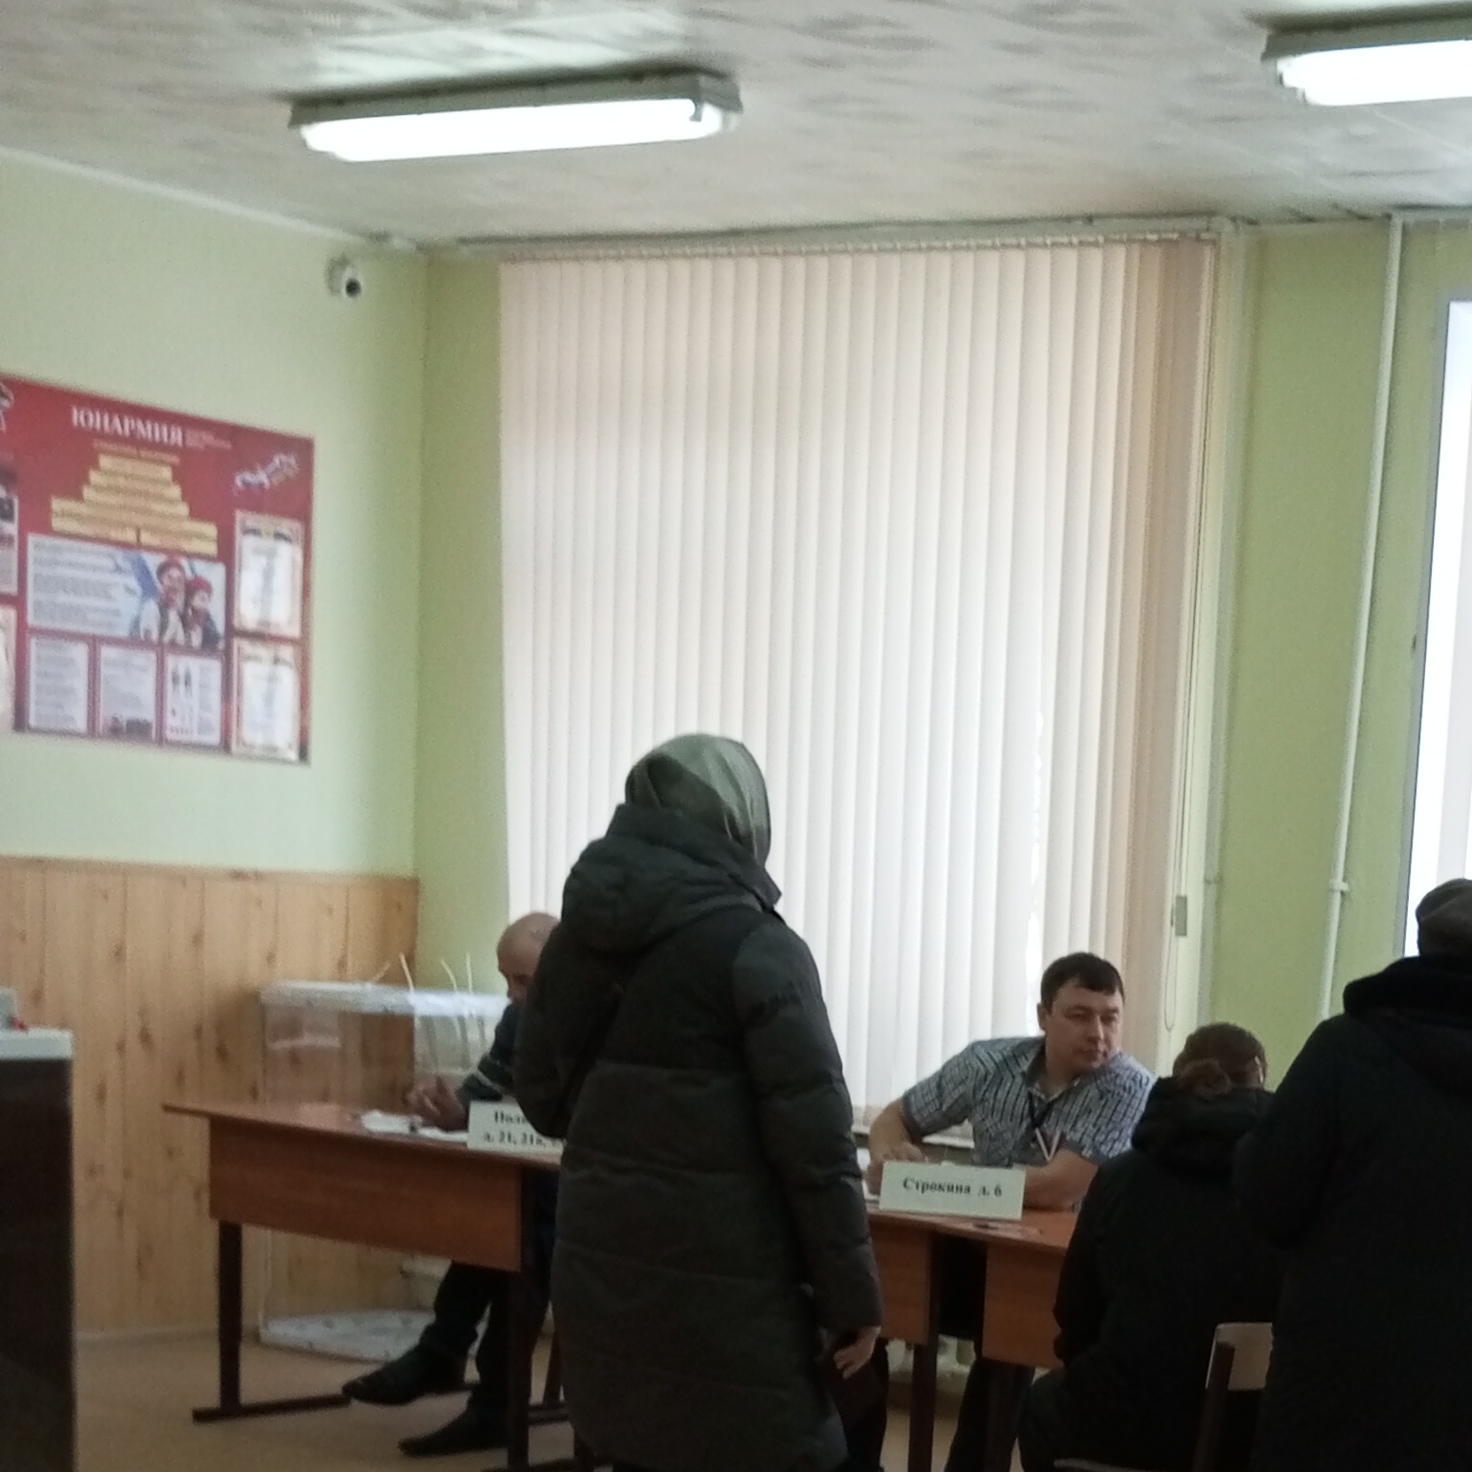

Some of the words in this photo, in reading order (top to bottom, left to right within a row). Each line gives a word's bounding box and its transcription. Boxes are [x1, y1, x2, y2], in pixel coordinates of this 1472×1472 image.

[72, 406, 184, 448] ЮНАРМИЯ
[903, 1176, 972, 1195] Строкина
[994, 1184, 1003, 1198] 6
